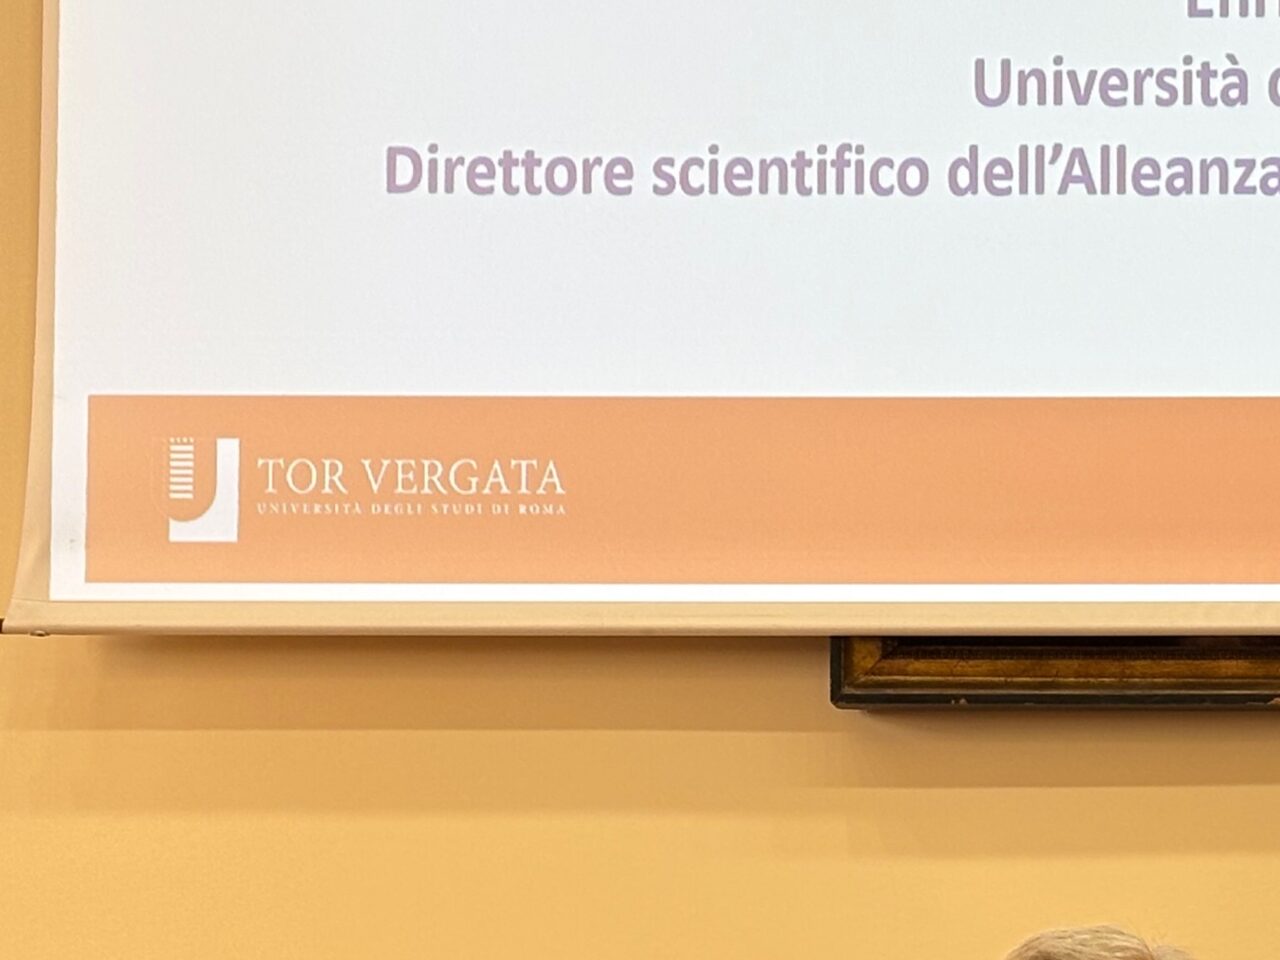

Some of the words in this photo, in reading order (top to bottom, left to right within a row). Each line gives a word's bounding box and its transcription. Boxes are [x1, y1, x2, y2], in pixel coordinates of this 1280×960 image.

[975, 53, 1250, 109] Università
[386, 143, 636, 198] Direttore
[653, 143, 931, 199] scientifico
[257, 458, 349, 495] TOR
[361, 458, 567, 495] VERGATA
[257, 501, 362, 516] UNIVERSITÀ
[371, 503, 423, 516] DEGLI
[431, 503, 483, 516] STUDI
[491, 503, 511, 516] DI
[518, 503, 567, 516] ROMA
